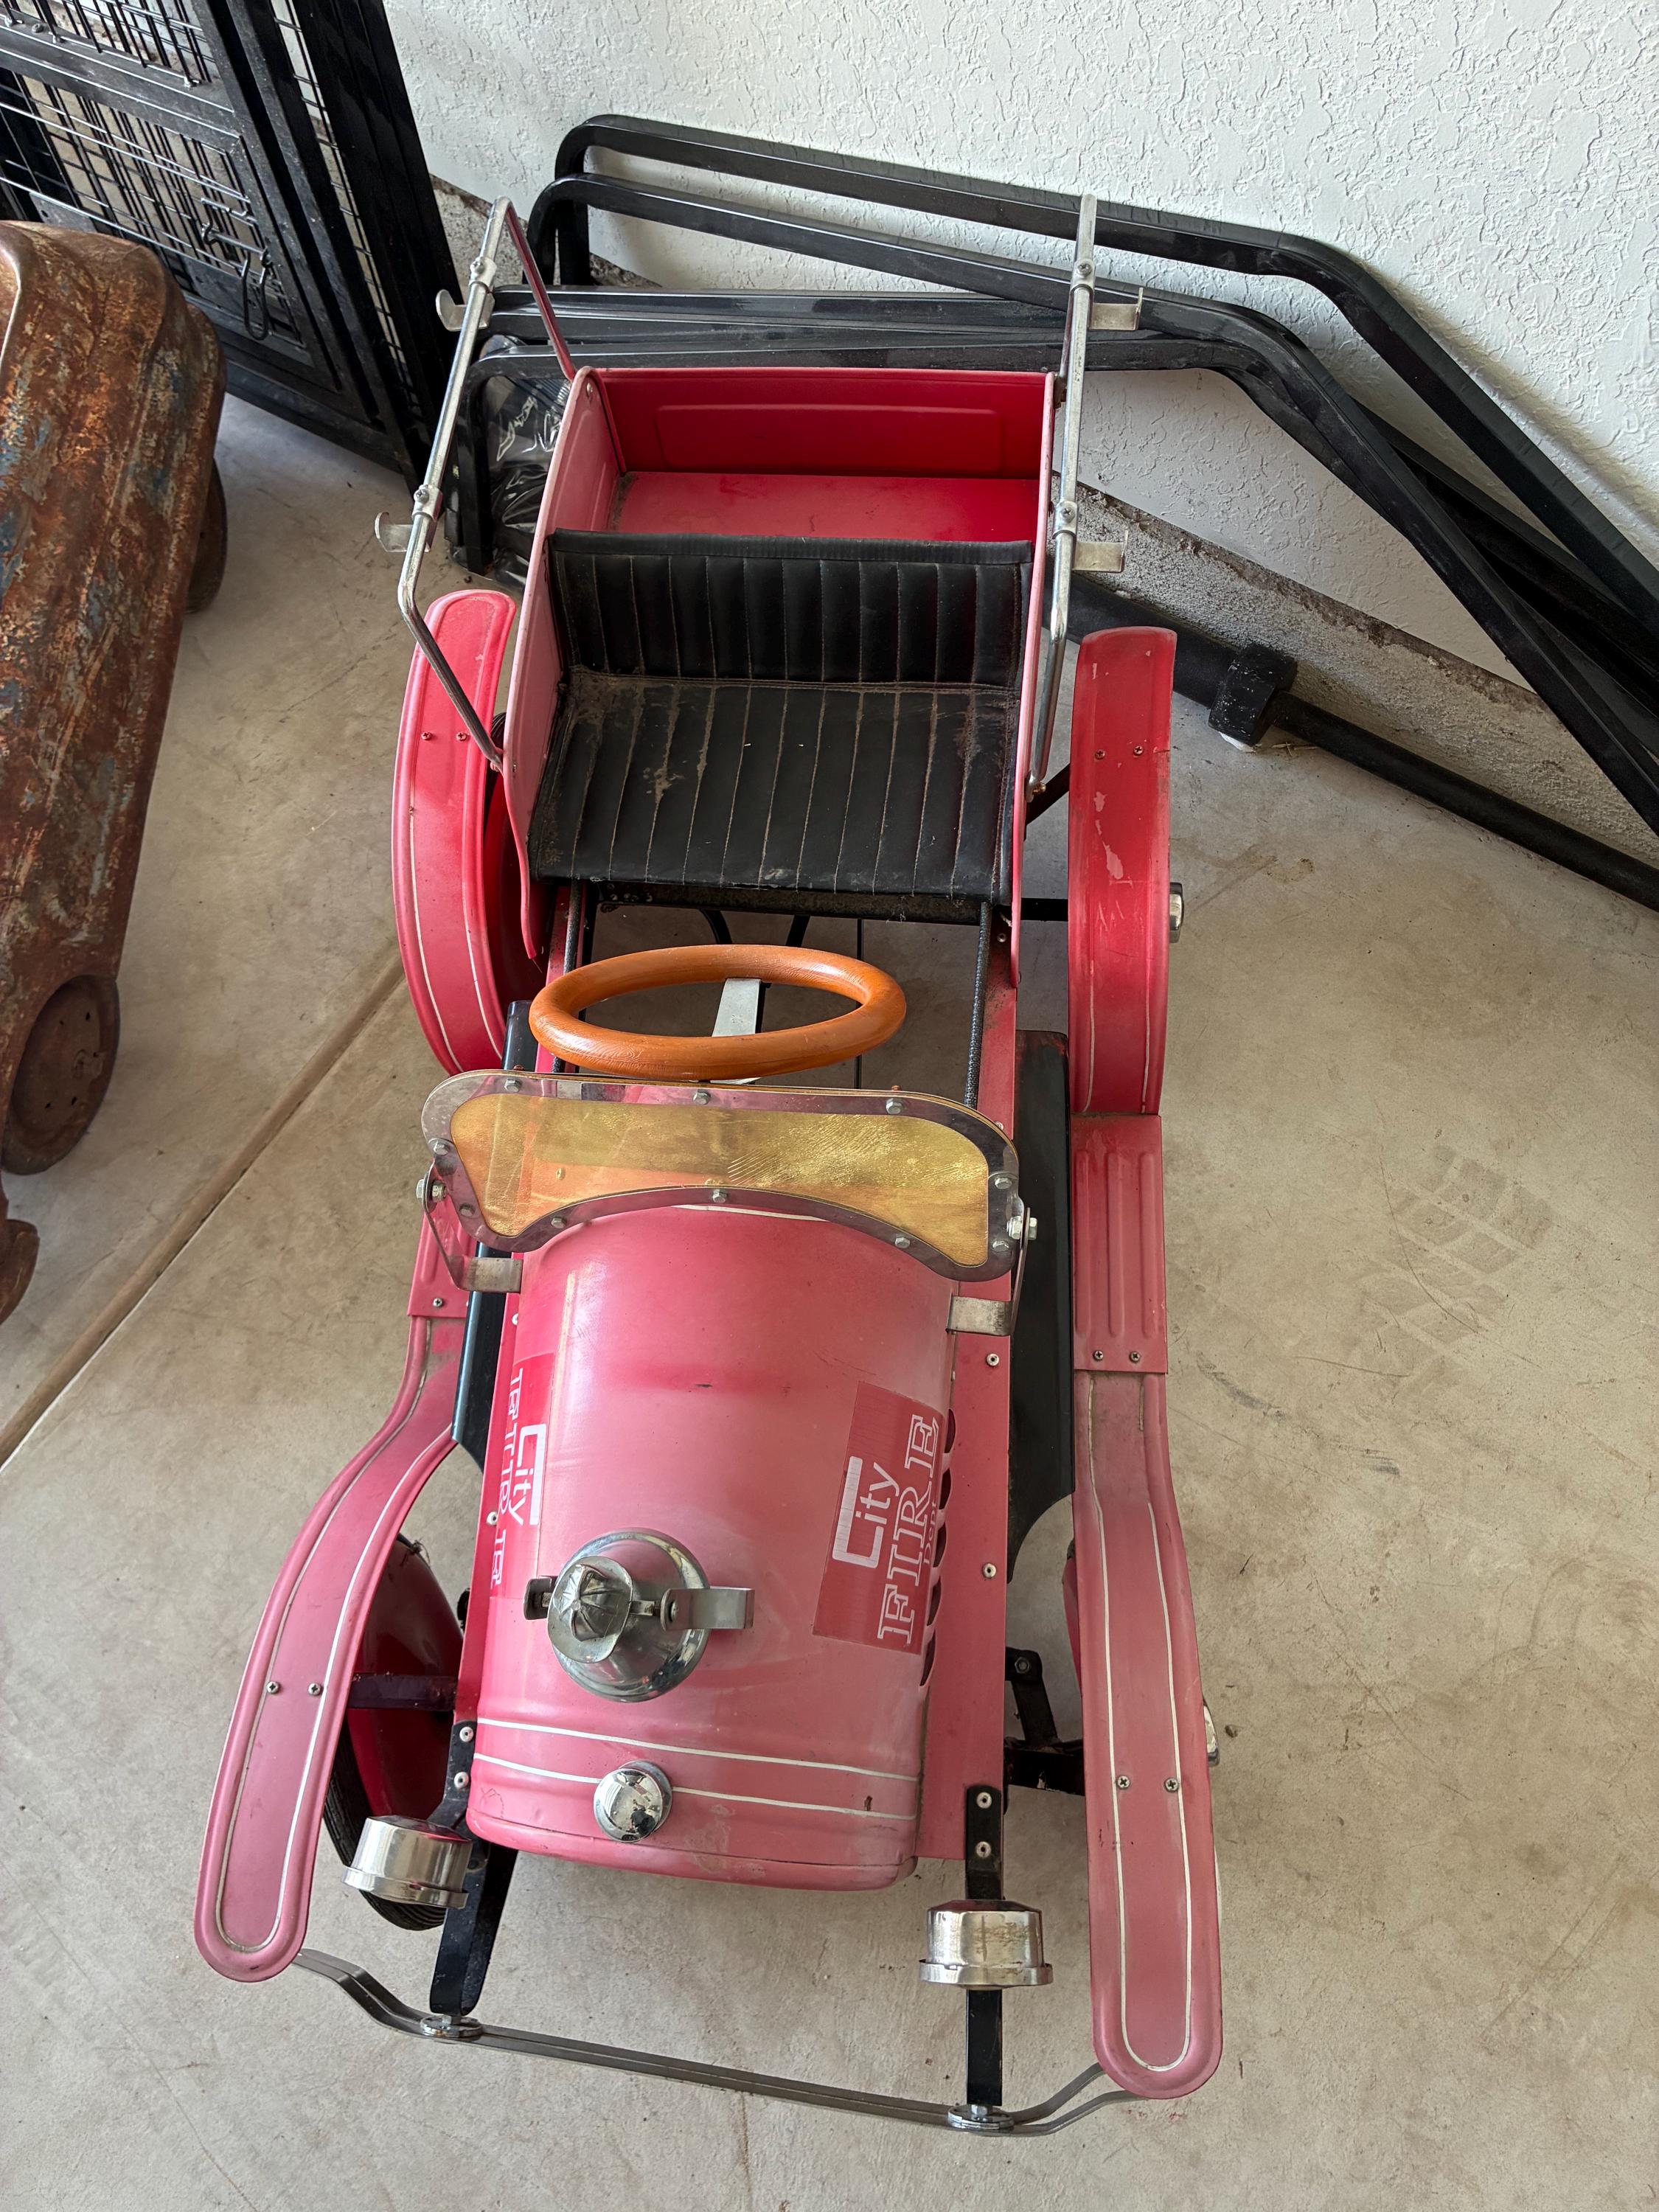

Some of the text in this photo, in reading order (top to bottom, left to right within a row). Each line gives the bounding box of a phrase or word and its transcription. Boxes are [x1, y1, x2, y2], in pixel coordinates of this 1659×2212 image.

[509, 1424, 547, 1526] City
[832, 1455, 900, 1568] City
[877, 1413, 939, 1645] FIRE
